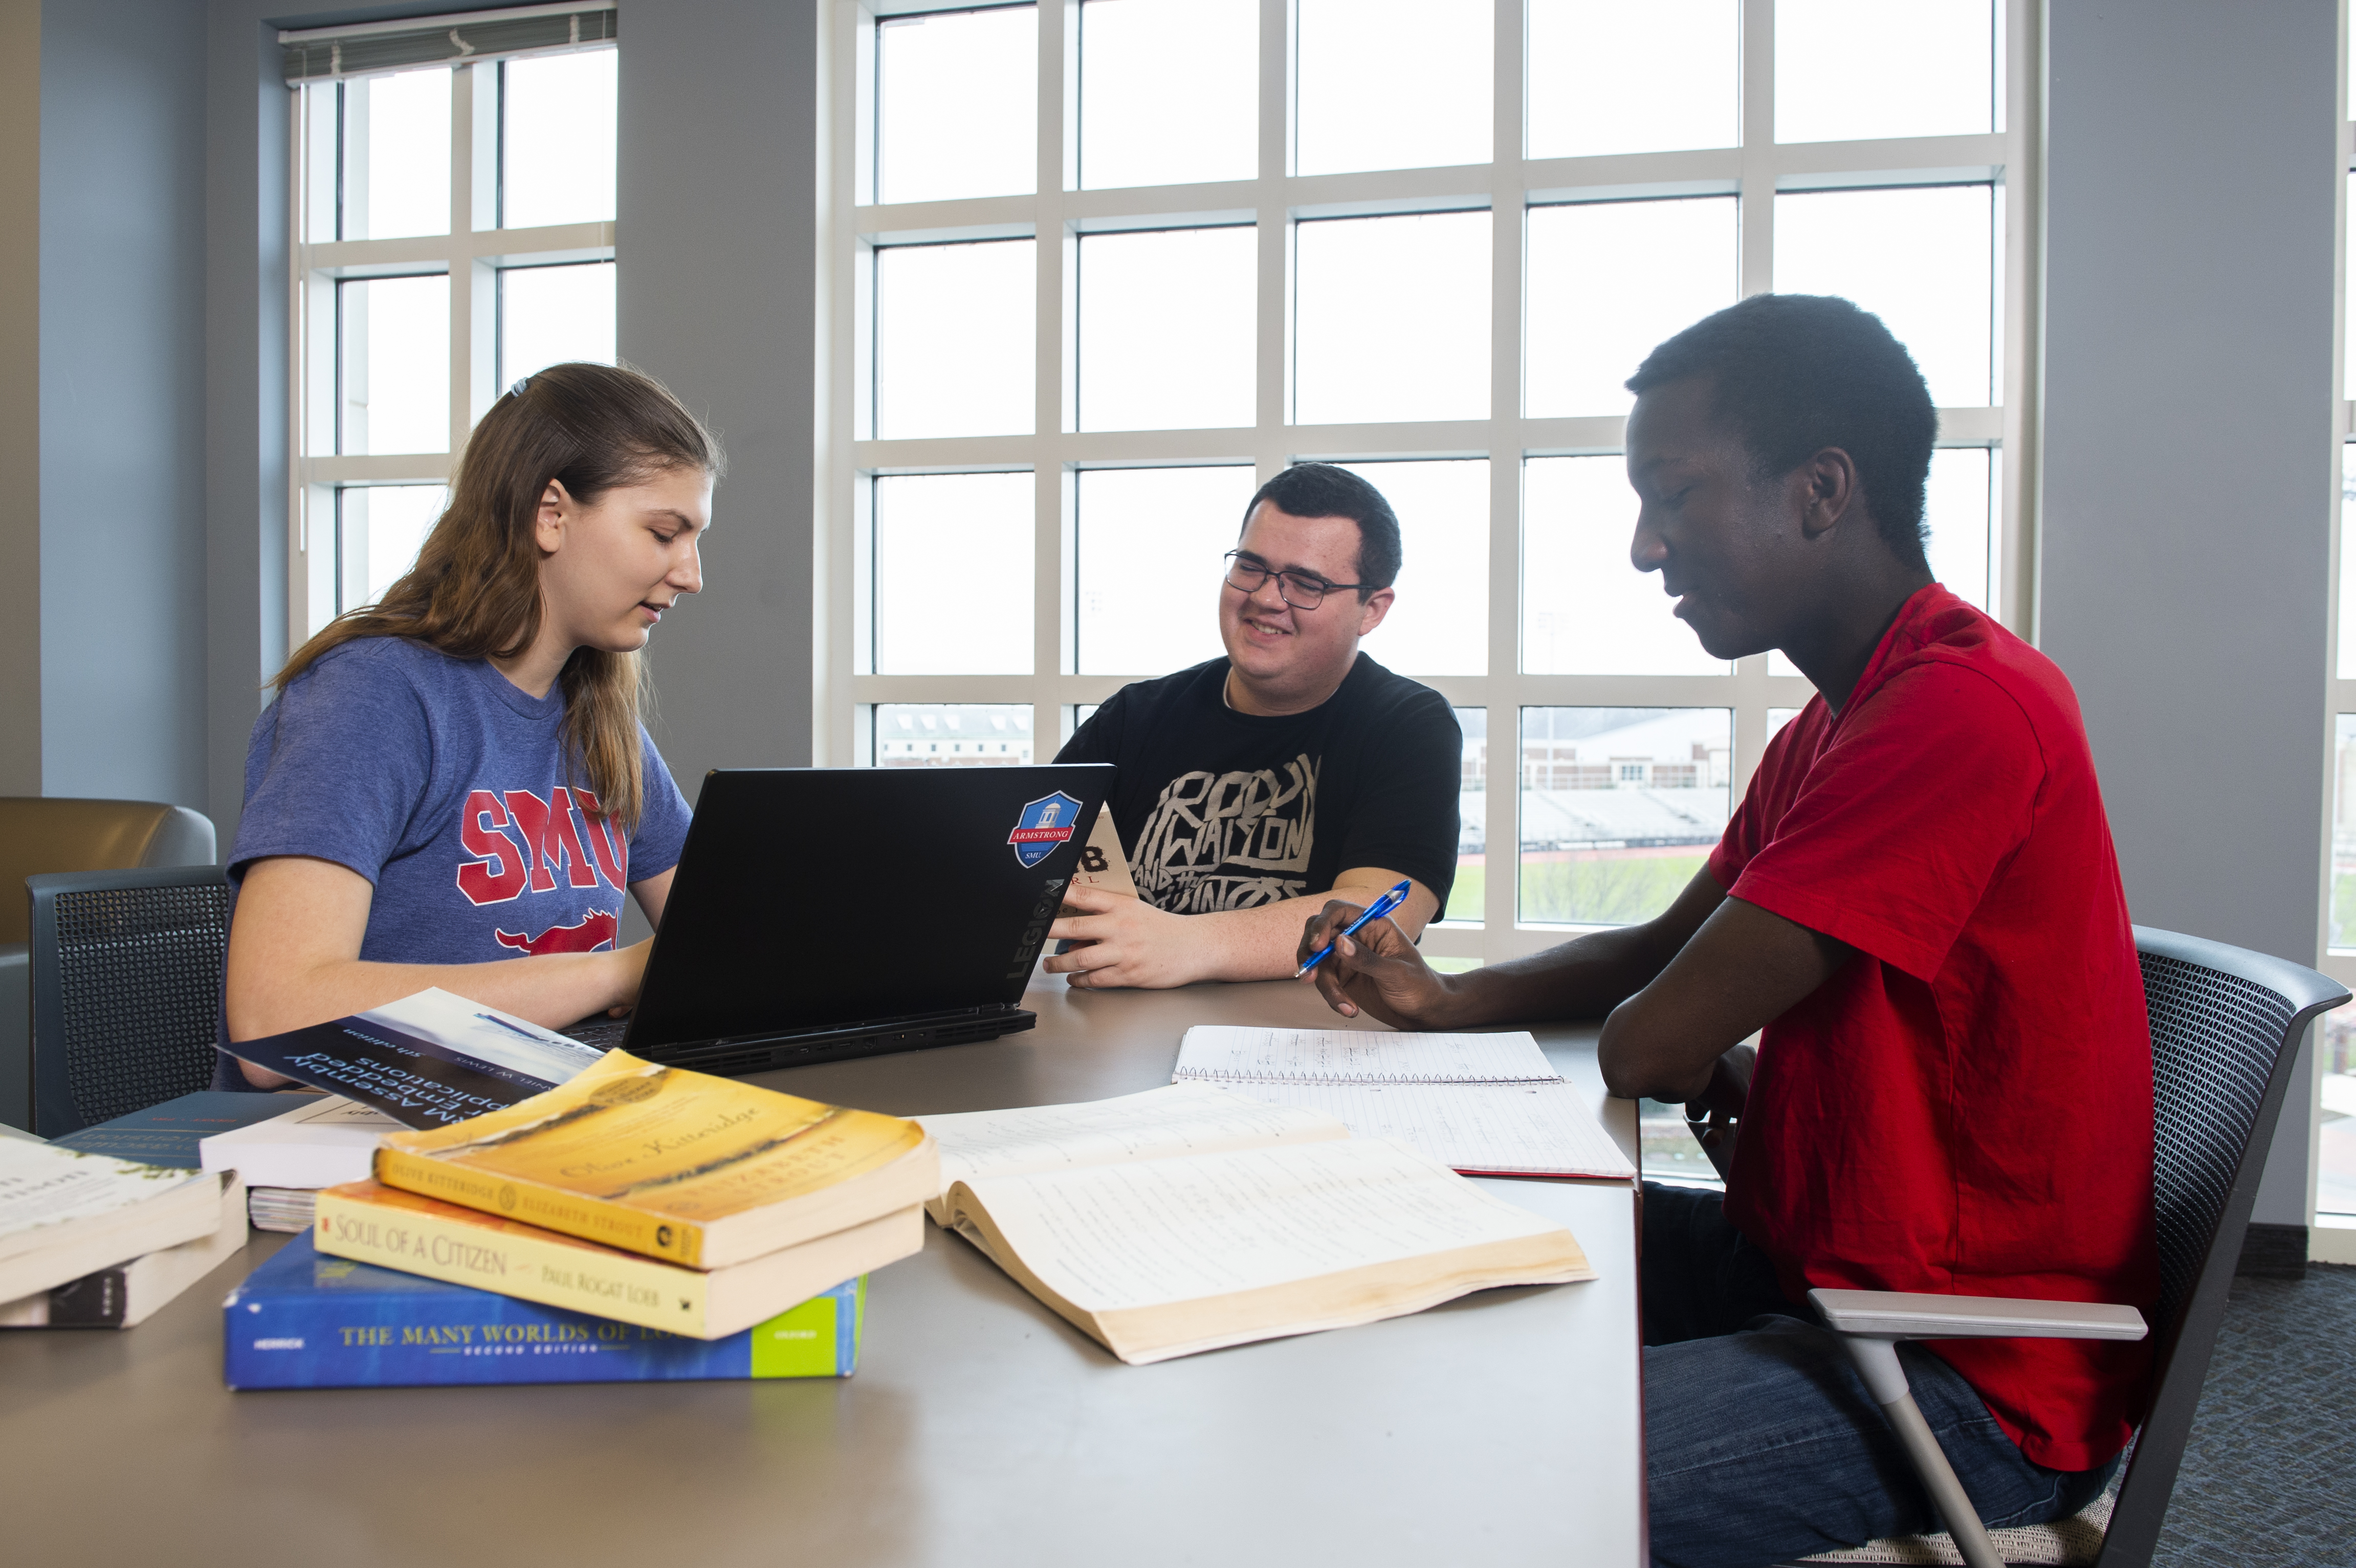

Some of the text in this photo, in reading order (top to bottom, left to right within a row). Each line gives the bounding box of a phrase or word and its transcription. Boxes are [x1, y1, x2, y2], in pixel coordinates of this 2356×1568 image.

[457, 786, 628, 907] SMU
[1013, 830, 1069, 840] ARMSTRONG
[1134, 858, 1174, 892] AND
[1006, 879, 1065, 979] LEGION
[343, 1028, 426, 1057] 5th edition
[453, 1056, 495, 1072] LEWIS
[282, 1055, 425, 1108] Assembly
[305, 1052, 462, 1111] Embedded
[355, 1057, 512, 1111] pplications
[335, 1213, 508, 1276] SOUL OF A CITIZEN
[541, 1265, 660, 1308] PAUL ROGAT LOEB
[338, 1326, 395, 1346] THE
[400, 1324, 475, 1345] MANY
[481, 1323, 590, 1343] WORLDS
[597, 1322, 631, 1341] OF
[464, 1343, 599, 1356] SECOND EDITION
